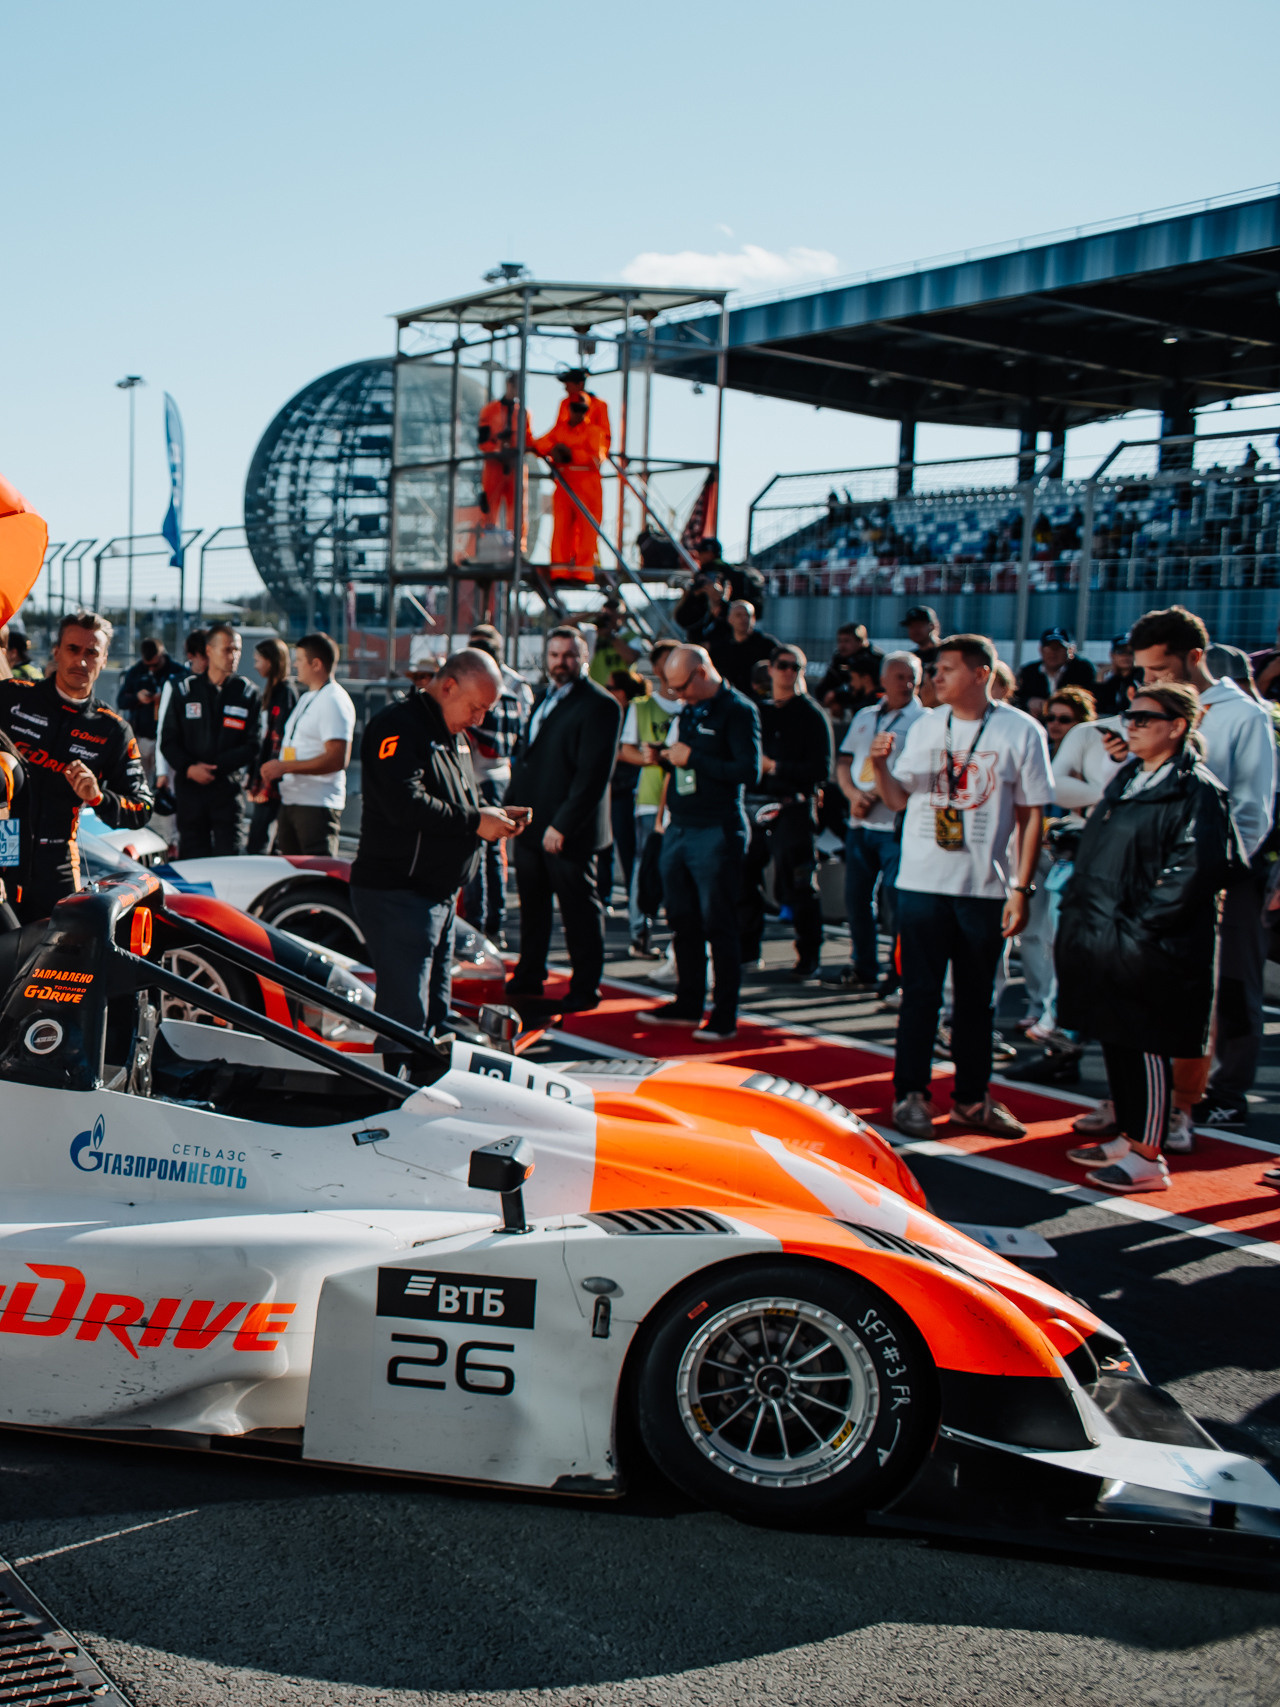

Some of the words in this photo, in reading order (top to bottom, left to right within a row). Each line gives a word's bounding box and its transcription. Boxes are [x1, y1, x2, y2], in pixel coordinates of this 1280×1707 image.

[31, 967, 94, 984] ЗАПРАВЛЕНО
[103, 1152, 247, 1190] ГАЗПРОМНЕФТЬ
[172, 1143, 211, 1158] СЕТЬ
[215, 1148, 247, 1163] АЗС
[437, 1283, 506, 1319] ВТБ
[387, 1332, 516, 1397] 26
[857, 1308, 897, 1344] SET
[890, 1384, 911, 1411] FR
